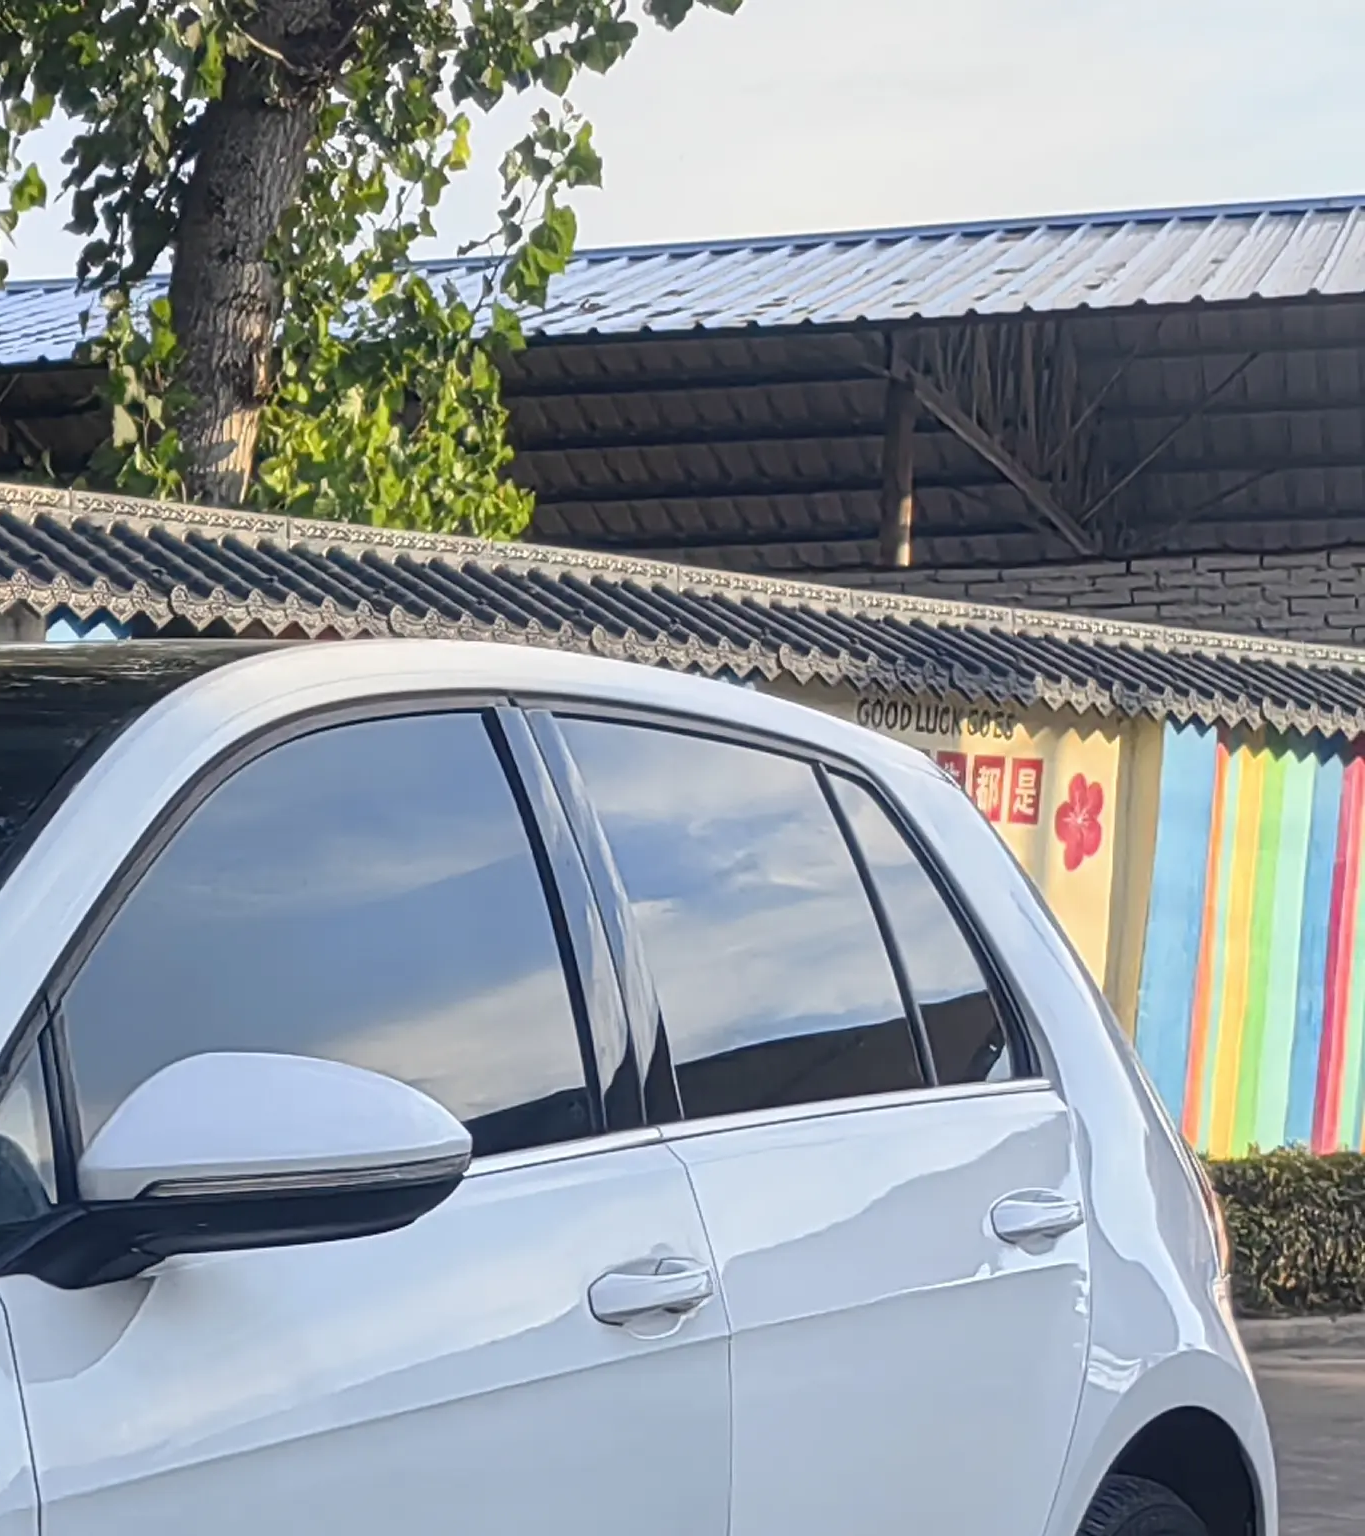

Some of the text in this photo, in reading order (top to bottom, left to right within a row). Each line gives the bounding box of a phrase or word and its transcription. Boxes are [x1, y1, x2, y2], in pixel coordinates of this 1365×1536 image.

[857, 698, 912, 732] GOOD
[916, 703, 962, 737] LUCK
[944, 761, 1037, 815] 都是
